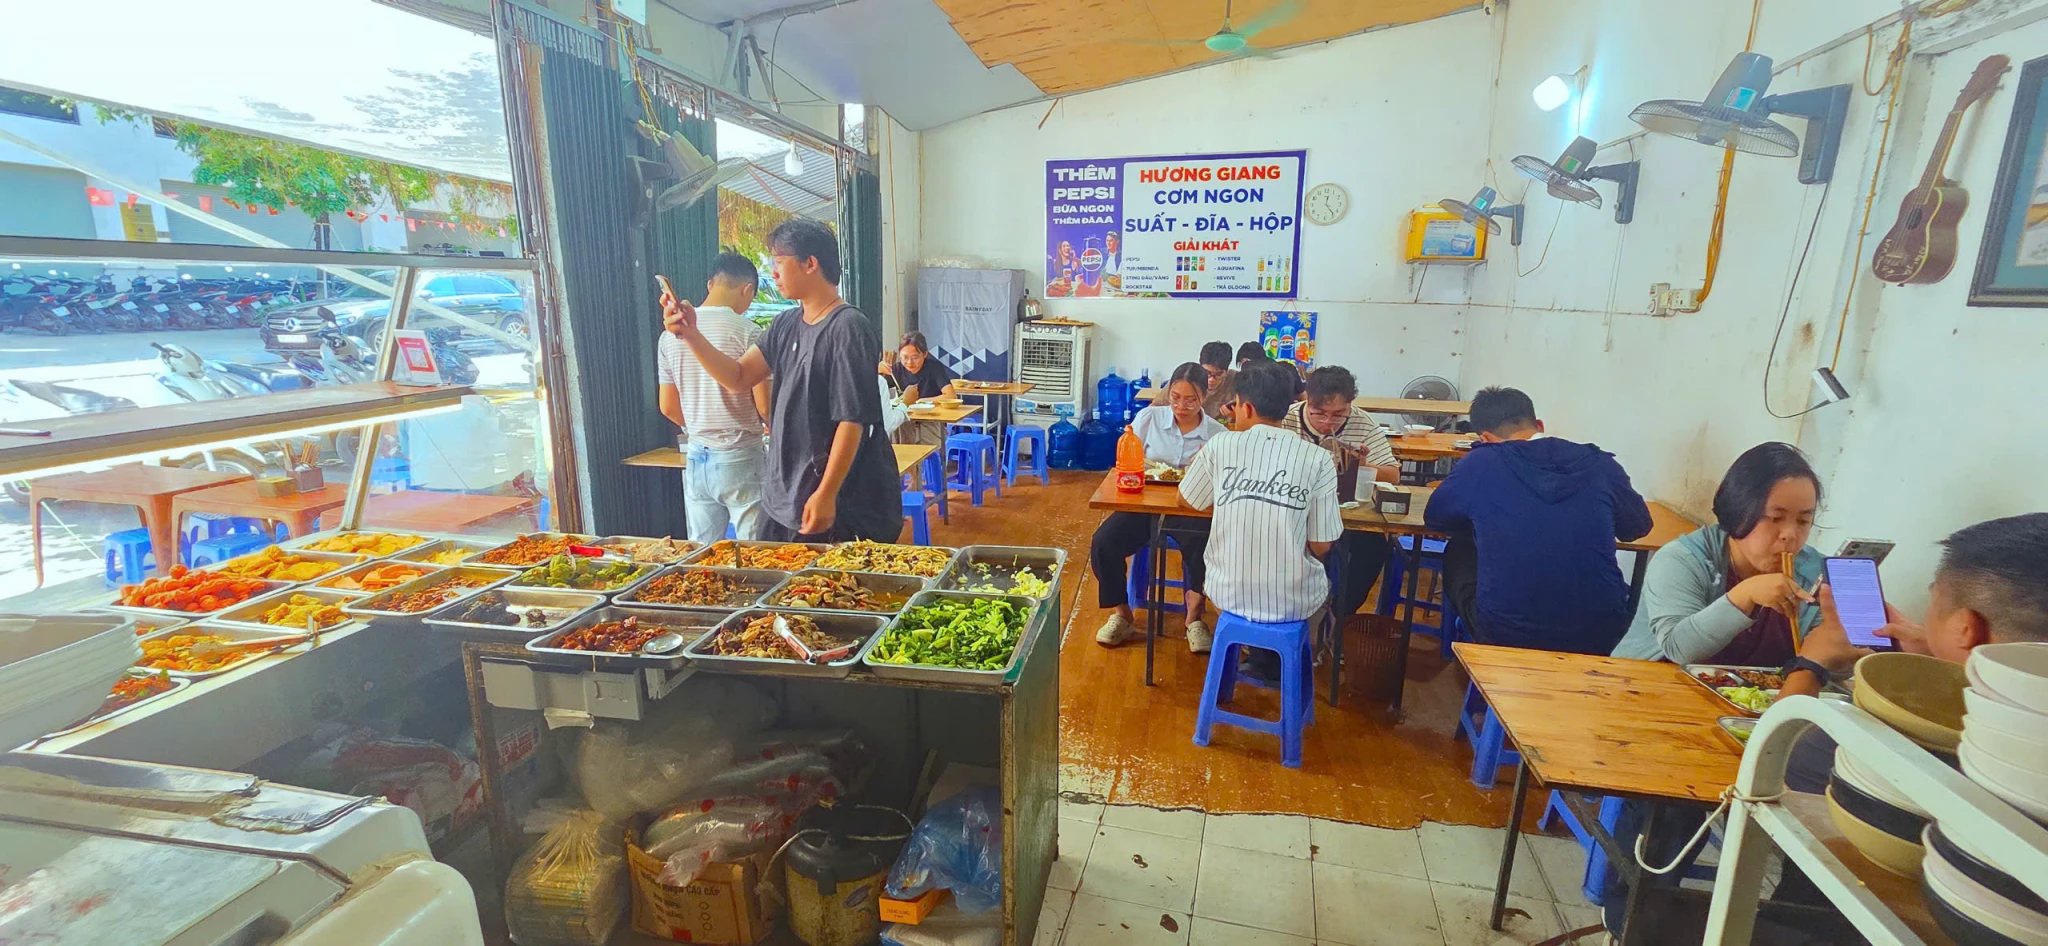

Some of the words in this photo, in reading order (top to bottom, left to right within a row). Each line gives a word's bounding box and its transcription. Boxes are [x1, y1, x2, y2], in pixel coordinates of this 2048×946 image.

[1053, 164, 1116, 181] THÊM
[1140, 166, 1212, 183] HƯƠNG
[1216, 165, 1281, 181] GIANG
[1053, 186, 1115, 200] PEPSI
[1154, 189, 1198, 205] CƠM
[1204, 188, 1264, 204] NGON
[1053, 204, 1078, 213] BỮA
[1079, 204, 1115, 213] NGON
[1053, 216, 1081, 224] THÊM
[1125, 212, 1177, 233] SUẤT
[1195, 214, 1230, 232] ĐĨA
[1249, 211, 1293, 234] HỘP
[1173, 237, 1200, 251] GIẢI
[1202, 238, 1240, 251] KHÁT
[1217, 466, 1309, 510] Yankees
